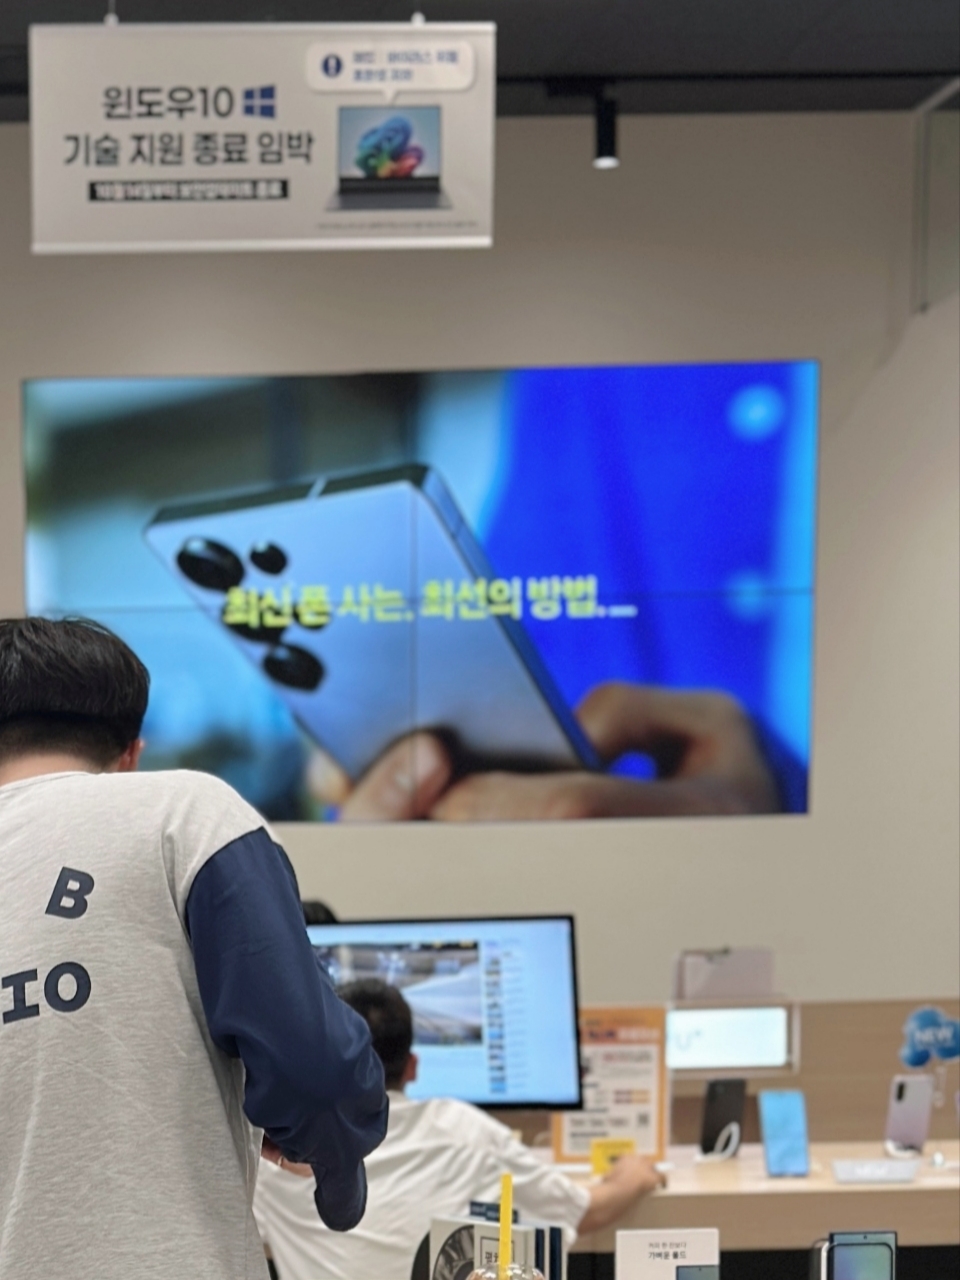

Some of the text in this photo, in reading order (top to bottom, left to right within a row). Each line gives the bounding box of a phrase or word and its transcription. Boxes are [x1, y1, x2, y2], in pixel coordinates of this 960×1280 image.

[102, 86, 234, 119] 윈도우10
[63, 130, 315, 166] 기술 지원 종료 임박
[222, 585, 294, 628] 최신
[422, 576, 521, 621] 최선의
